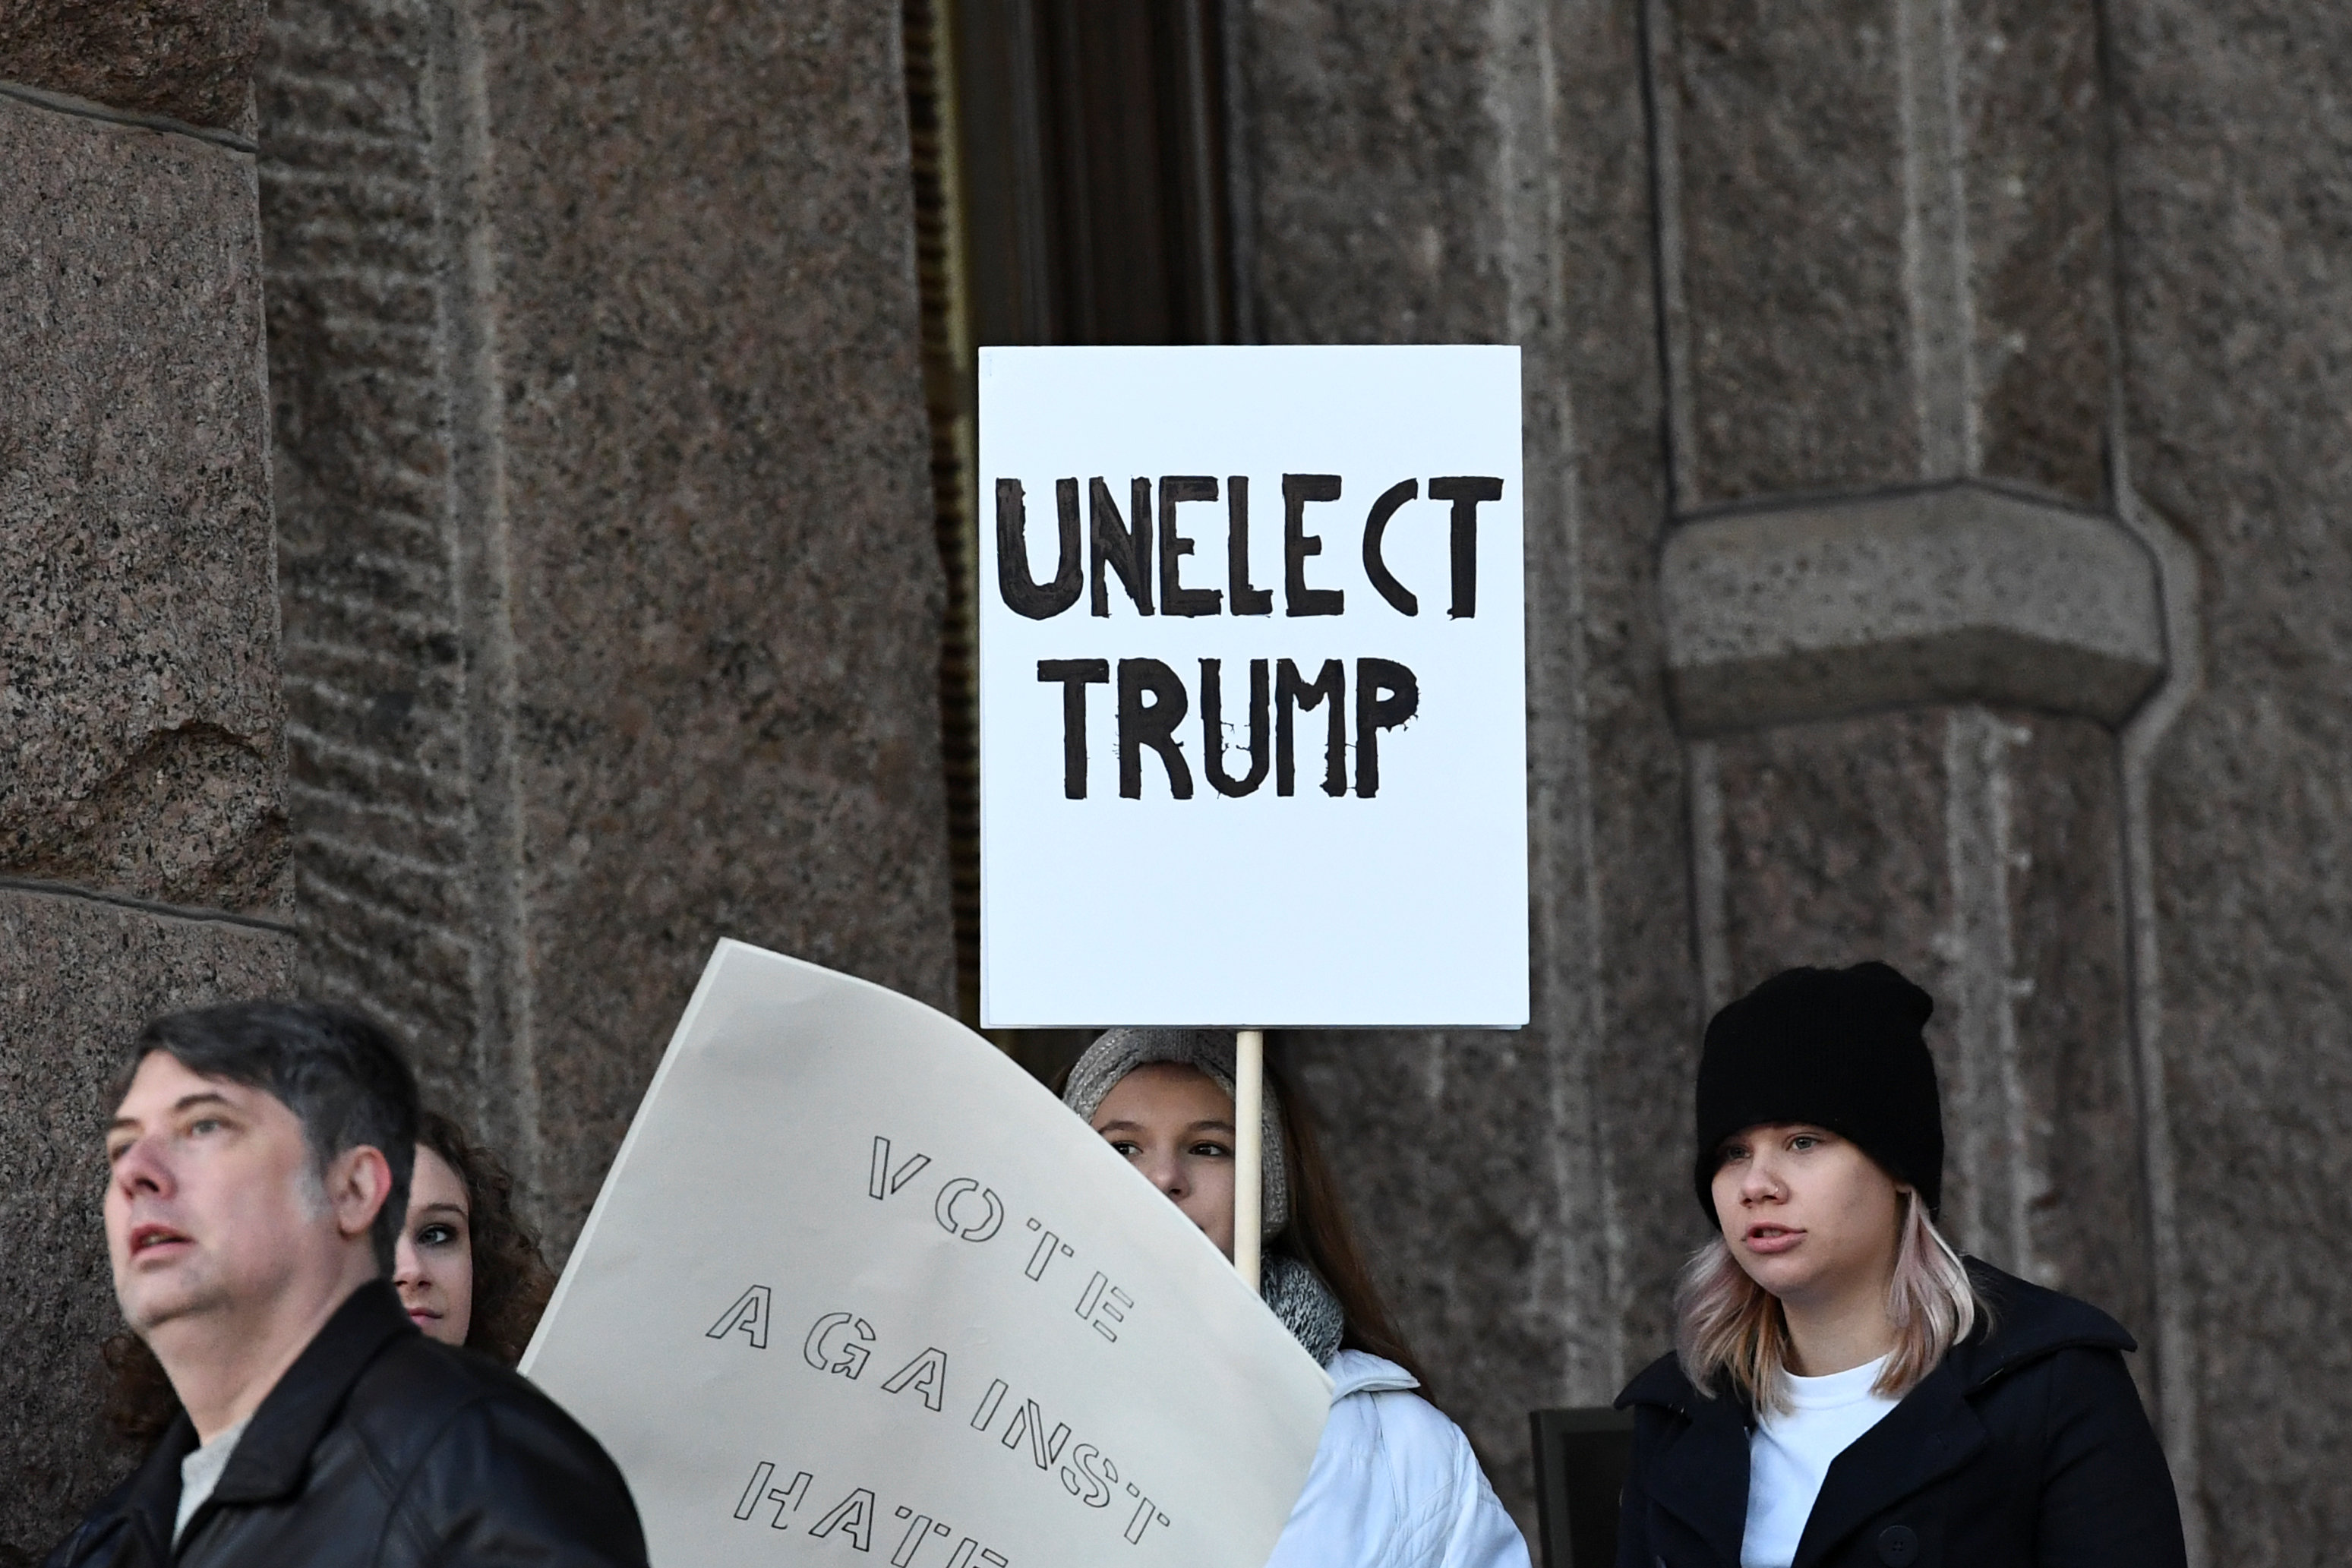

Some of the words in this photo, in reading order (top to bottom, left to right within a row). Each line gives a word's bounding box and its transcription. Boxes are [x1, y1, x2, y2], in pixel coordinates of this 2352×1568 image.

[996, 474, 1504, 620] UNELECT
[1037, 658, 1419, 800] TRUMP
[870, 1136, 1134, 1342] VOTE
[706, 1285, 1170, 1544] AGAINST
